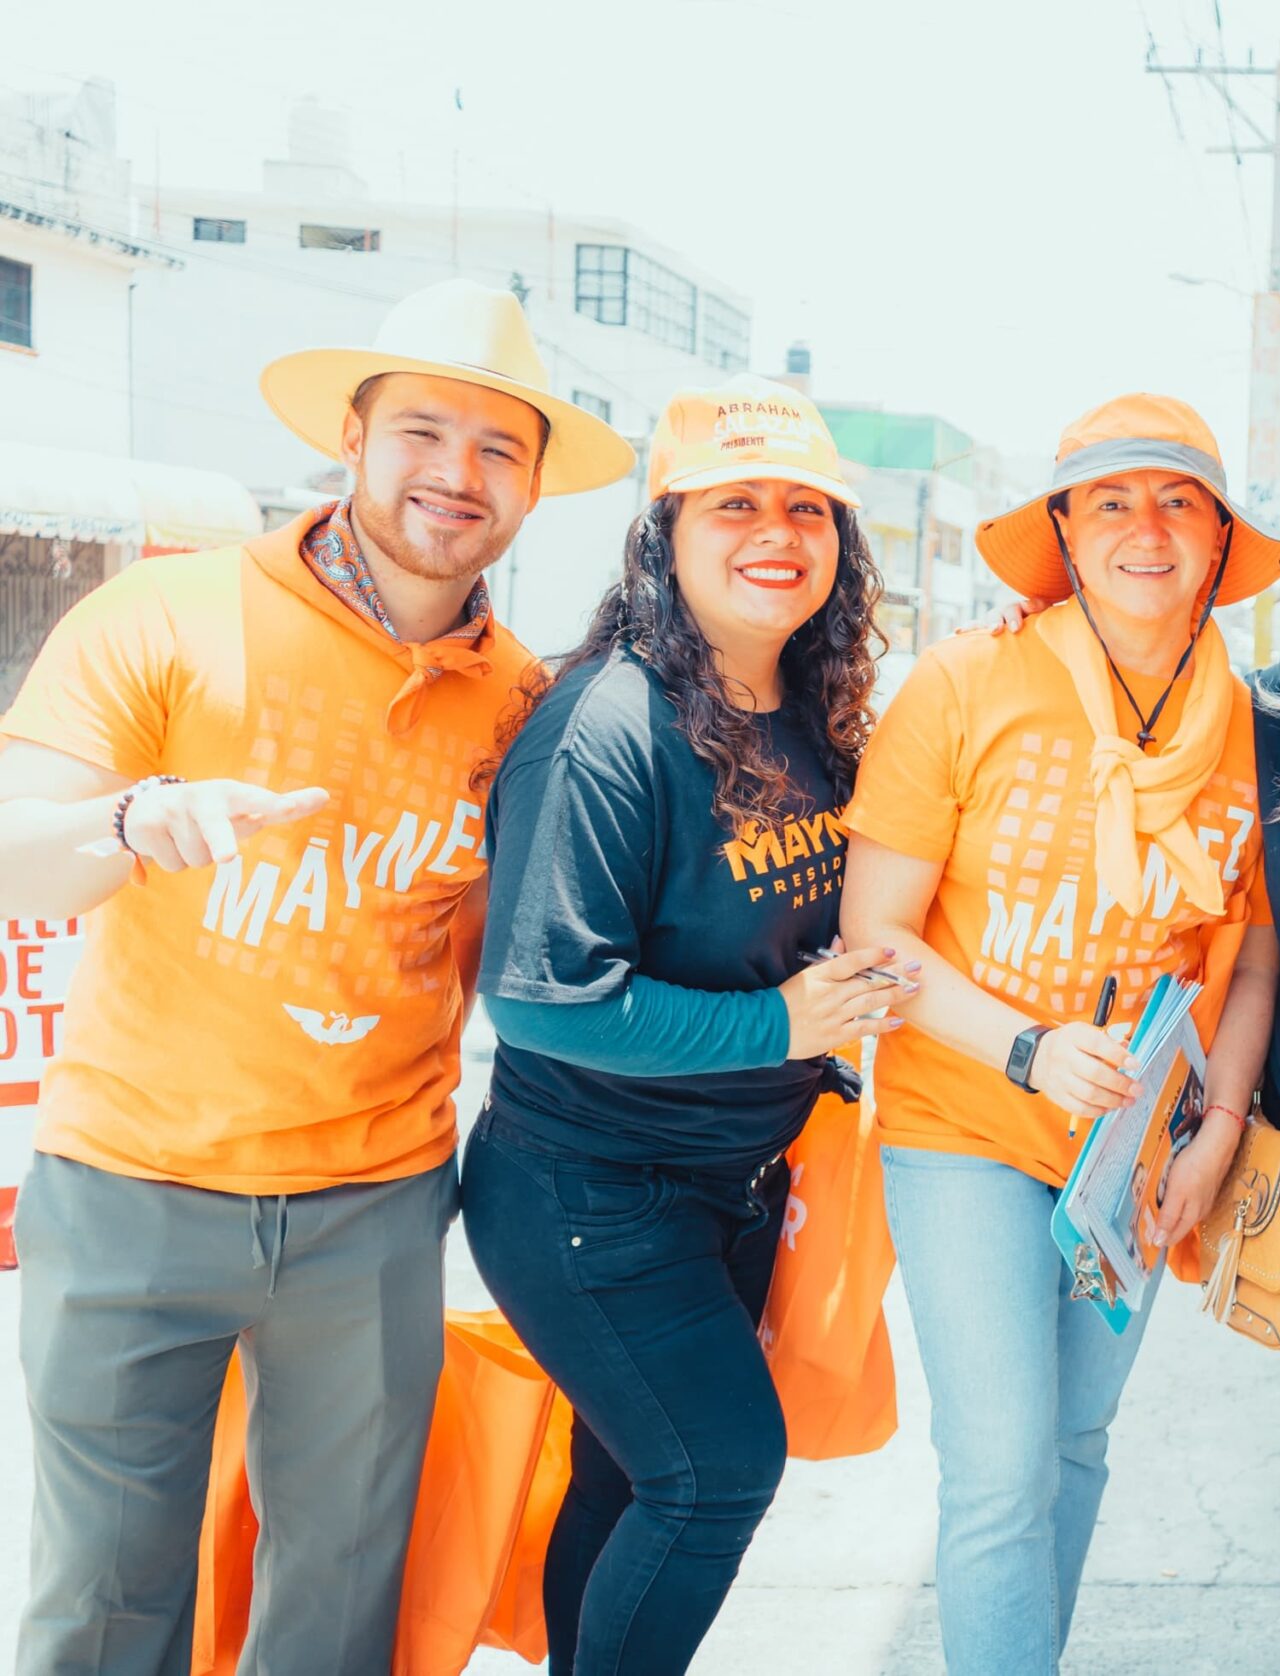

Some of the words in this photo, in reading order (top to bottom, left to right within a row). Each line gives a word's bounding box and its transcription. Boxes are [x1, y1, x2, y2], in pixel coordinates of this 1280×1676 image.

[717, 402, 801, 419] ABRAHAM
[723, 805, 850, 882] MÁYN
[202, 798, 489, 947] MÁYNE
[749, 851, 848, 903] PRESID
[793, 874, 843, 909] MÉXI
[0, 945, 44, 999] E
